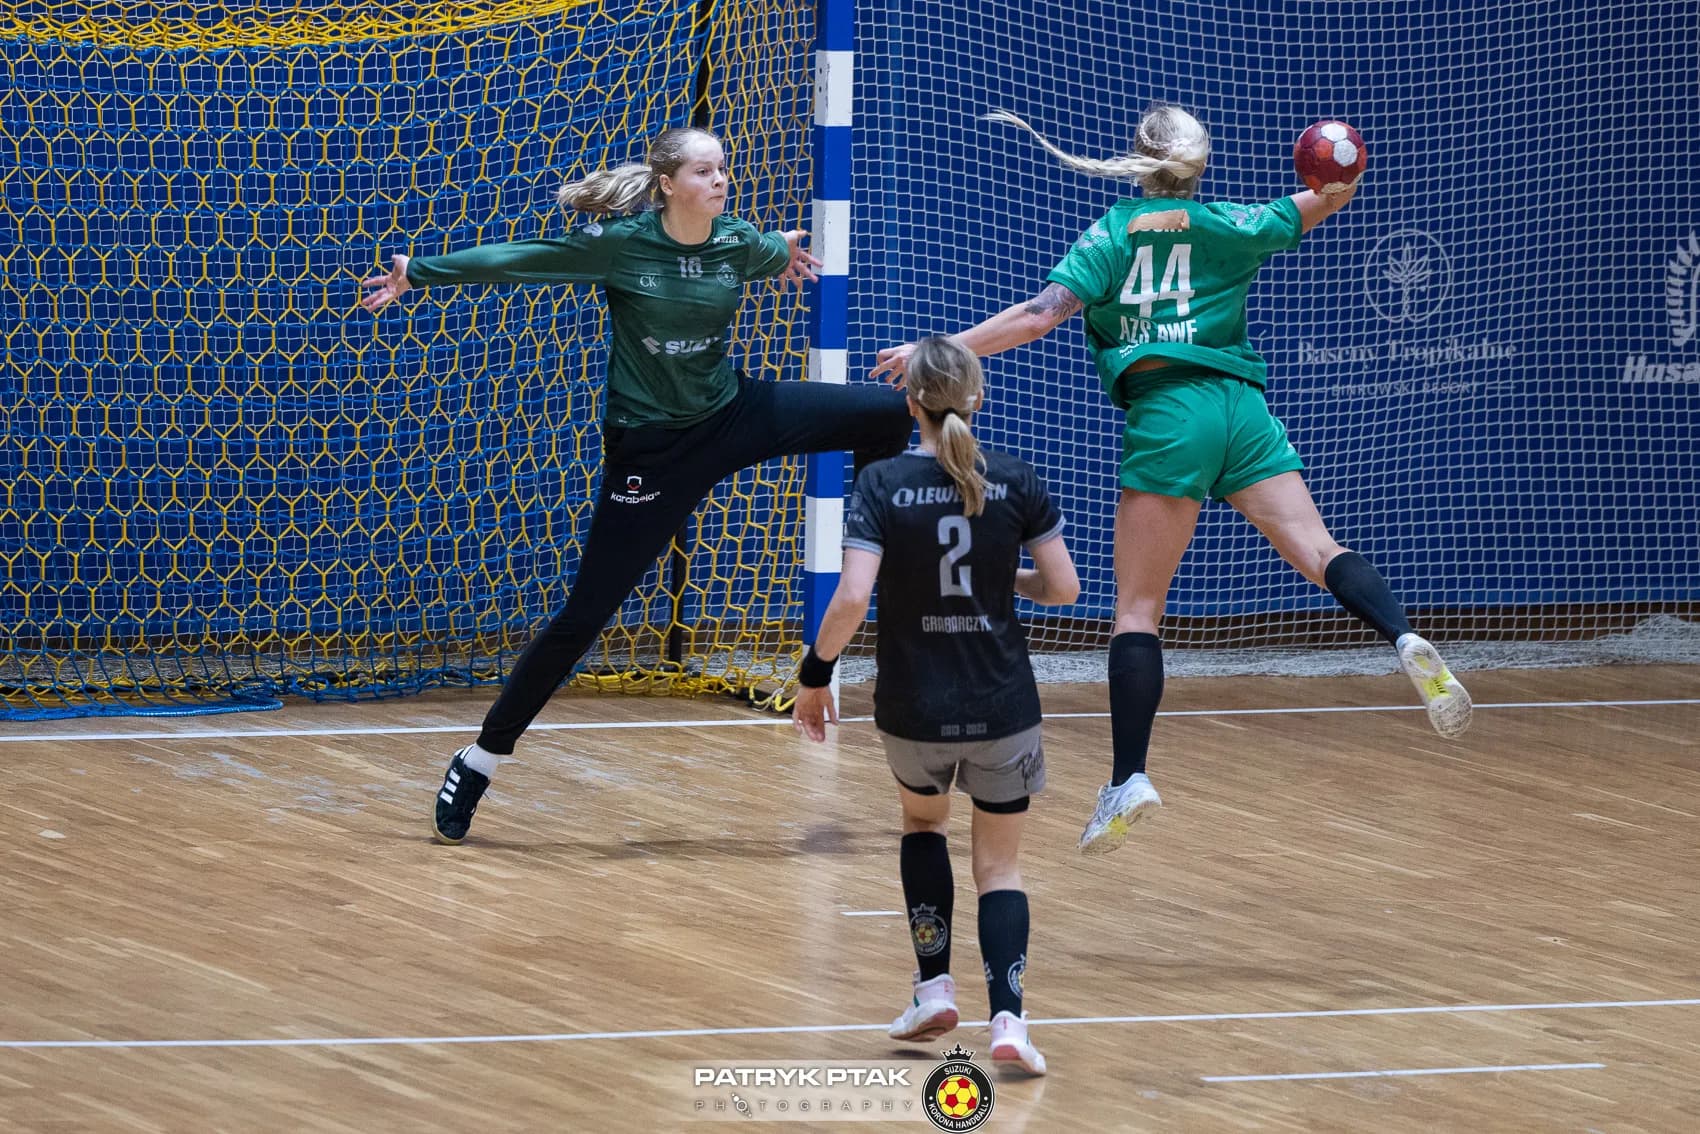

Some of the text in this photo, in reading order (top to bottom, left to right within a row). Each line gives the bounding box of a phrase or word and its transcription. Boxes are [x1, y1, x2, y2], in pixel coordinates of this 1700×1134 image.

[639, 275, 656, 288] CK
[1120, 243, 1196, 318] 44
[1120, 315, 1152, 345] AZS
[610, 491, 655, 504] karabela
[938, 515, 973, 597] 2
[921, 615, 992, 634] GRABARCZYK
